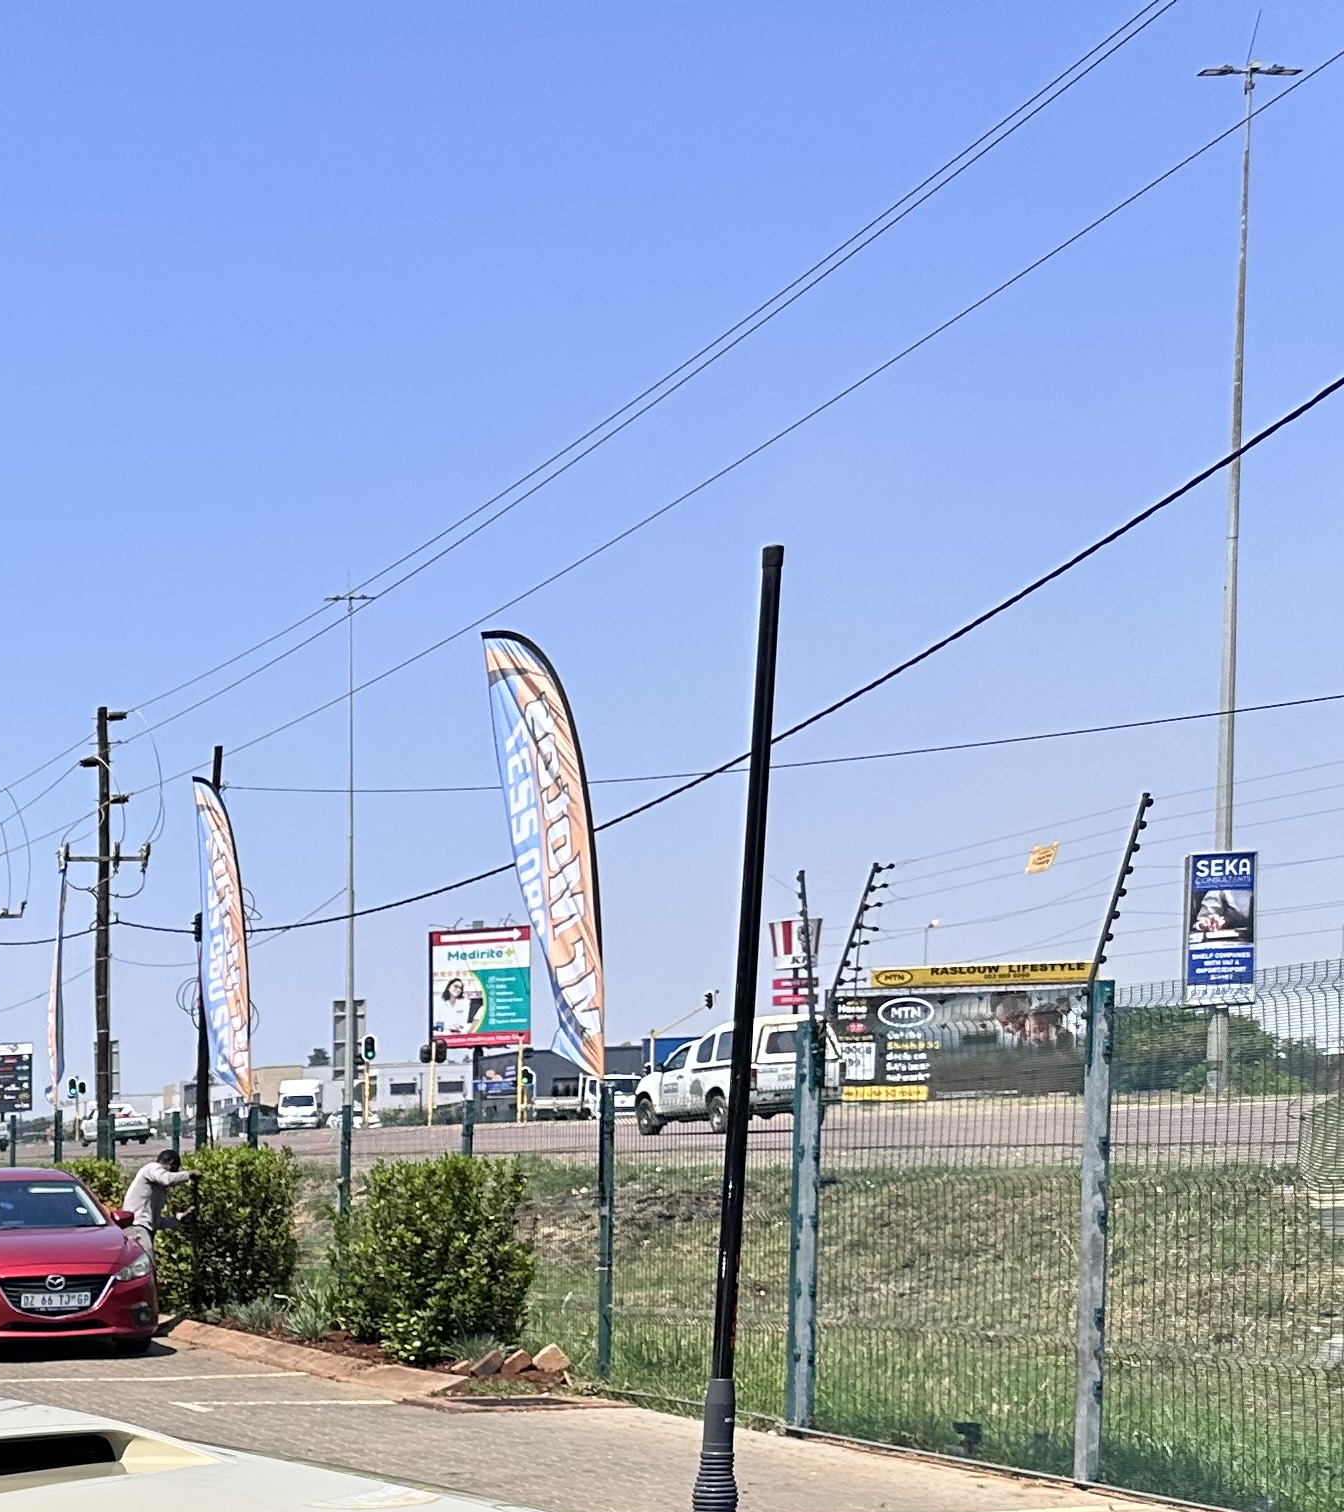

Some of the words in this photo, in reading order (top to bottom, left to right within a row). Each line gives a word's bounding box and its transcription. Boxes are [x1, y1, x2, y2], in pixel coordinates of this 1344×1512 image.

[1196, 859, 1251, 877] SEKA
[1195, 875, 1252, 886] CONSULTANTS
[930, 965, 1000, 976] RASLOUW
[1008, 962, 1086, 973] LIFESTYLE
[884, 974, 905, 982] MTN
[890, 1006, 922, 1019] MTN
